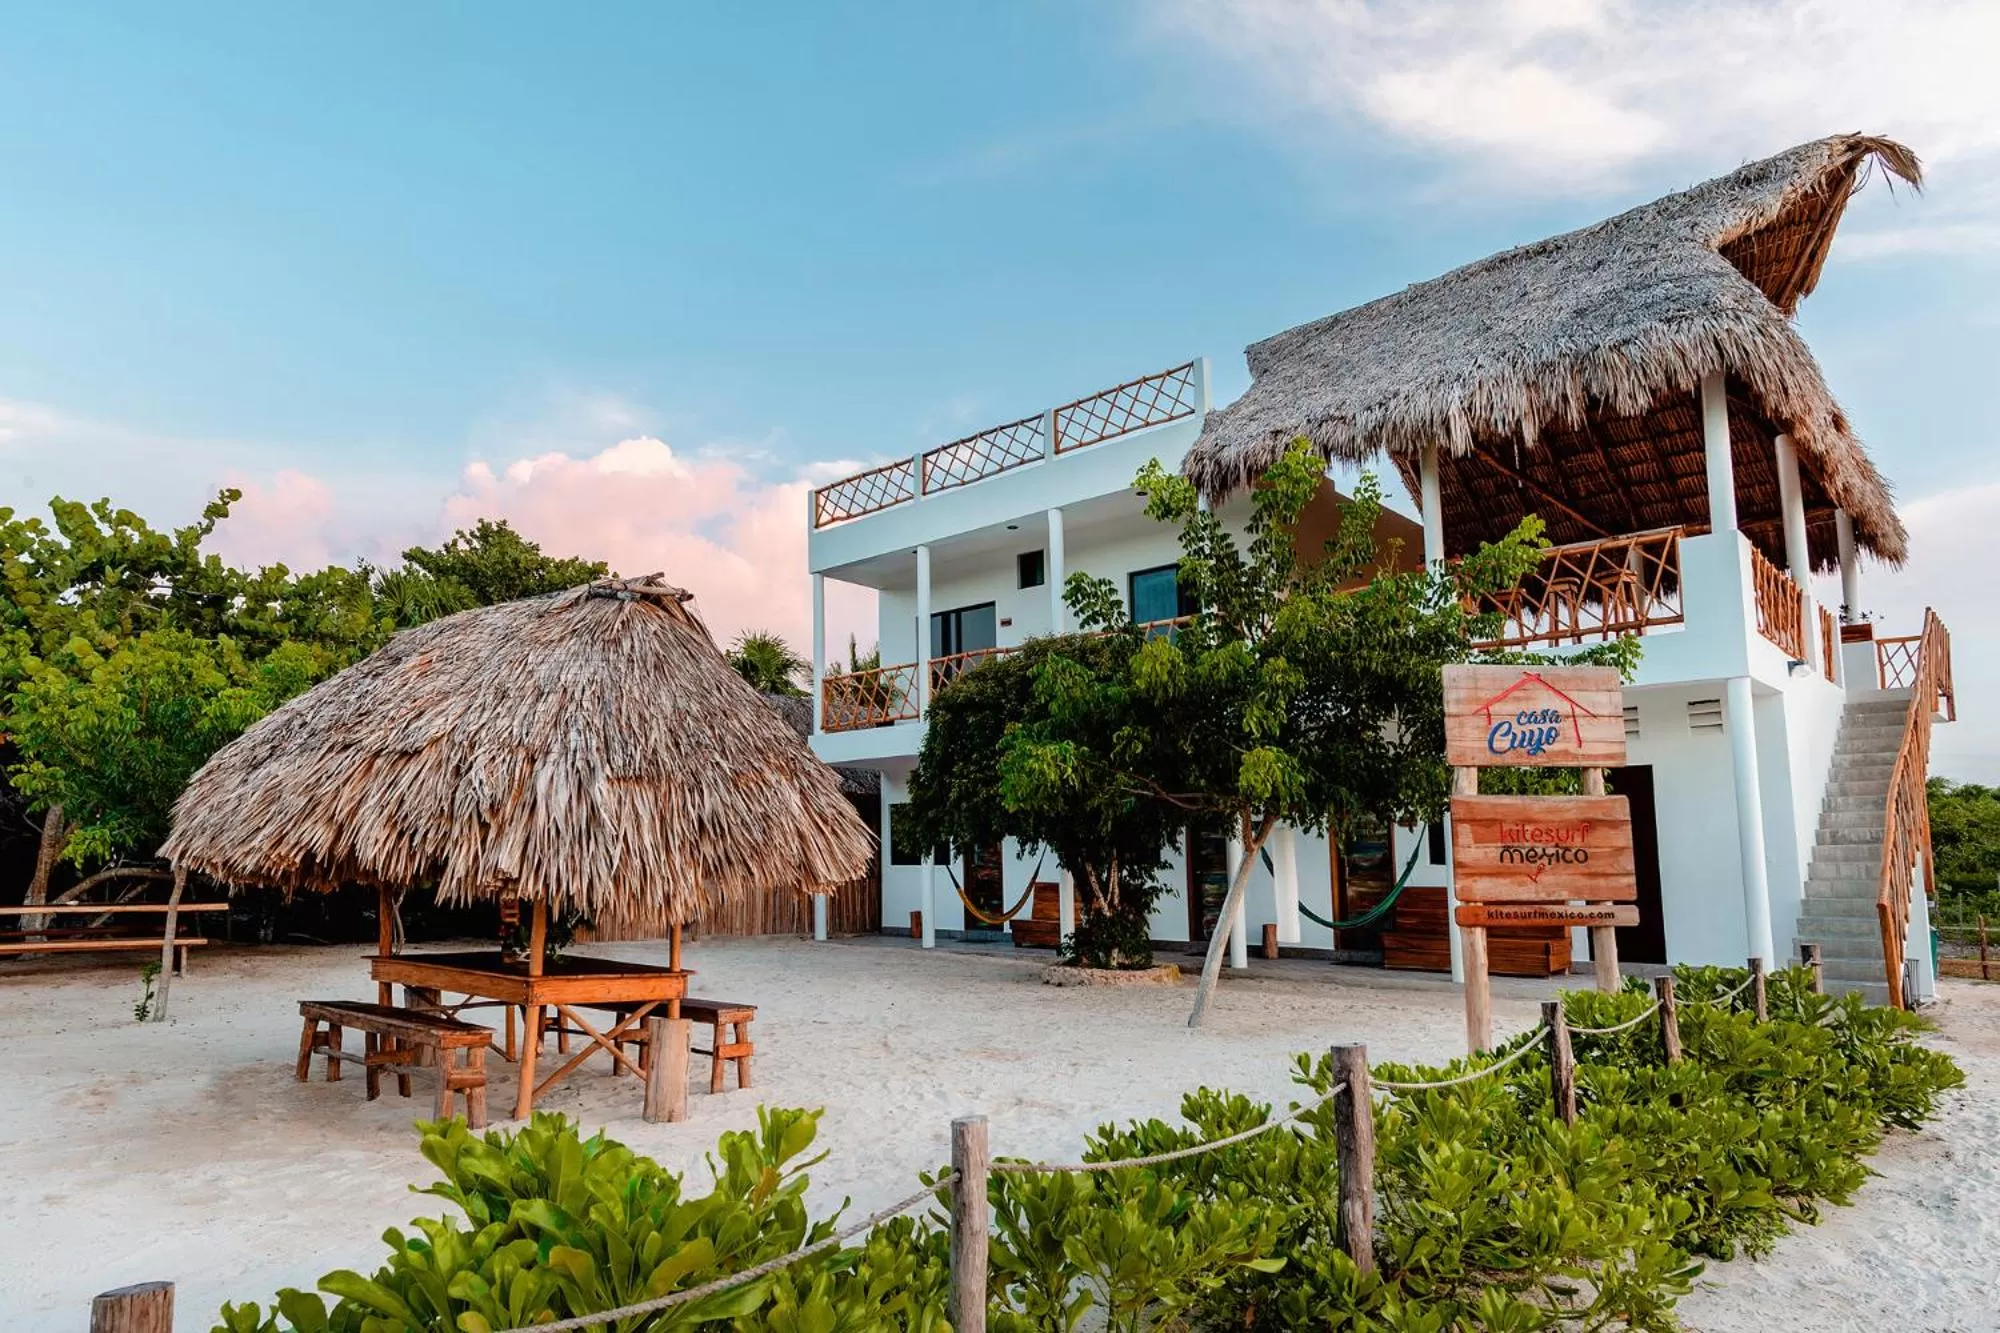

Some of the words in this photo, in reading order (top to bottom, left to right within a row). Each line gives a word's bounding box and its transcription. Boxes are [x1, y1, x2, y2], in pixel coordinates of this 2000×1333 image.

[1516, 709, 1562, 725] casa
[1487, 720, 1560, 756] Cuyo
[1500, 822, 1590, 843] kitesurf
[1499, 843, 1589, 865] mexico
[1487, 909, 1615, 920] kitesurfmexico.com
